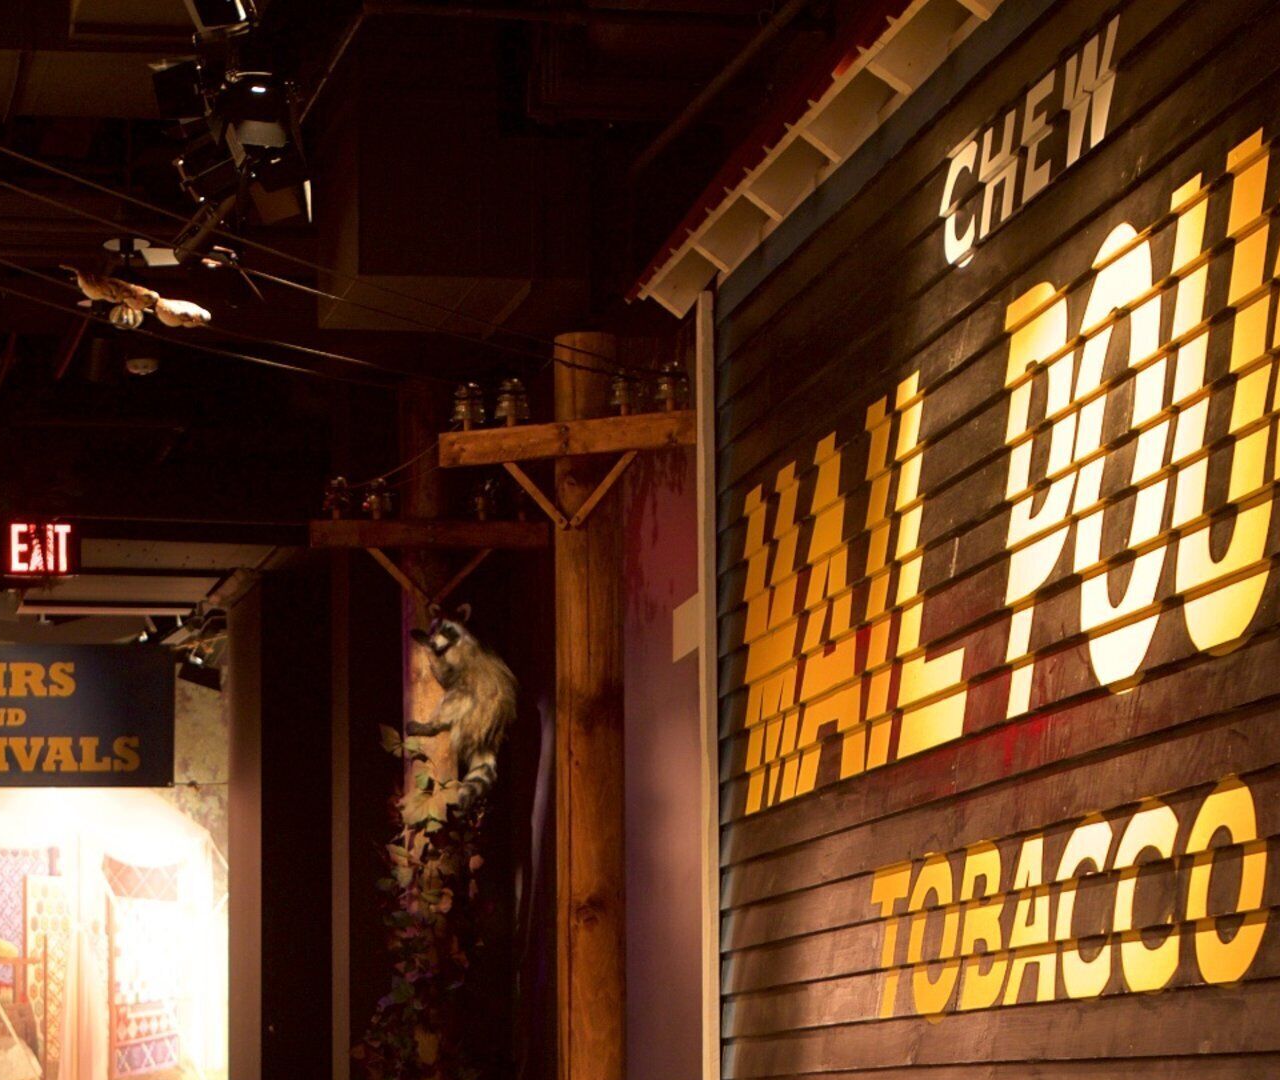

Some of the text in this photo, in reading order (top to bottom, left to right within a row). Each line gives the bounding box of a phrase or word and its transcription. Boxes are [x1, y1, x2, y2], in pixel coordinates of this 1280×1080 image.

[939, 14, 1120, 268] CHEW
[744, 370, 968, 816] MAIL
[871, 774, 1270, 1023] TOBACCO
